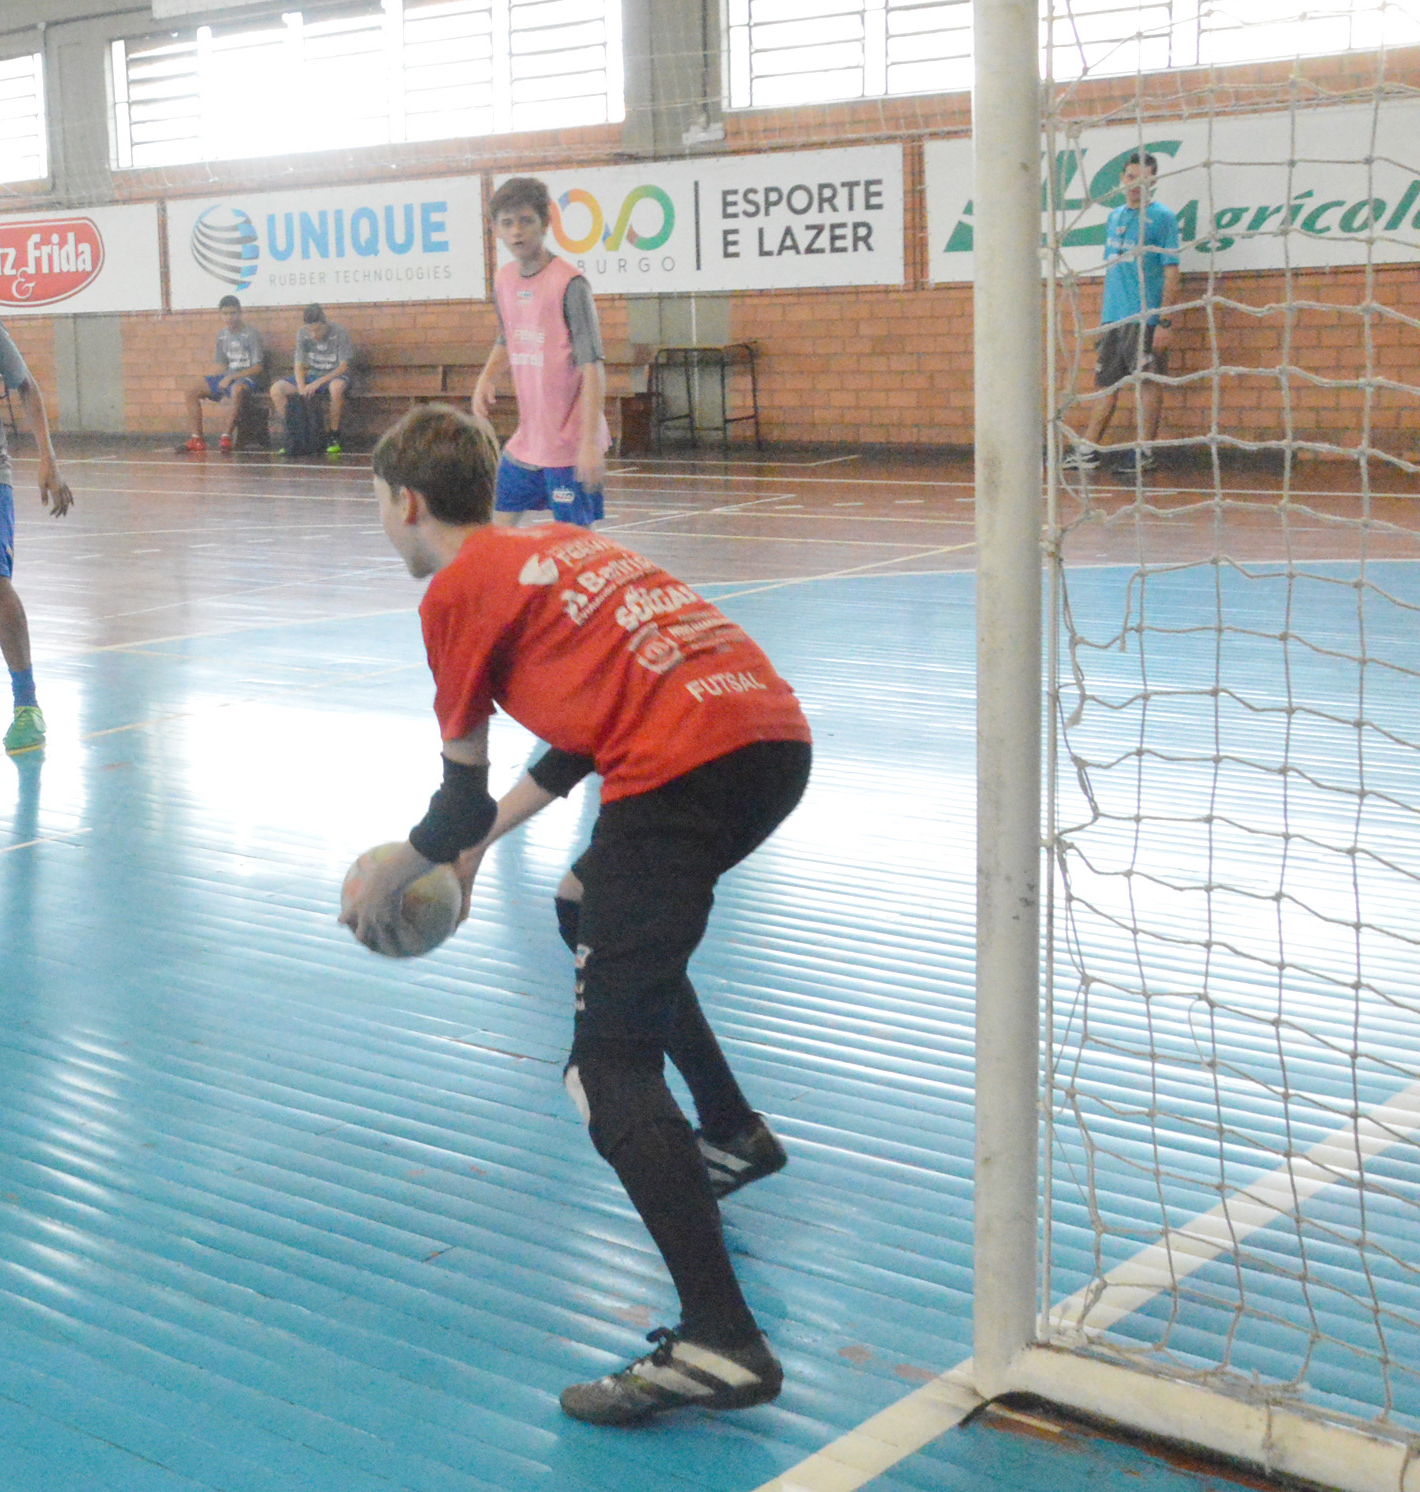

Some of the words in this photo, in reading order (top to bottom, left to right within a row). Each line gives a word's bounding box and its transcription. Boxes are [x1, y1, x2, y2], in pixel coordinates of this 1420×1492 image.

[720, 179, 884, 220] ESPORTE
[266, 200, 450, 261] UNIQUE
[722, 228, 740, 258] E
[757, 221, 875, 257] LAZER
[24, 231, 93, 275] Frida
[576, 255, 676, 275] BURGO
[269, 271, 328, 286] RUBBER
[334, 264, 452, 284] TECHNOLOGIES
[685, 671, 767, 703] FUTSAL
